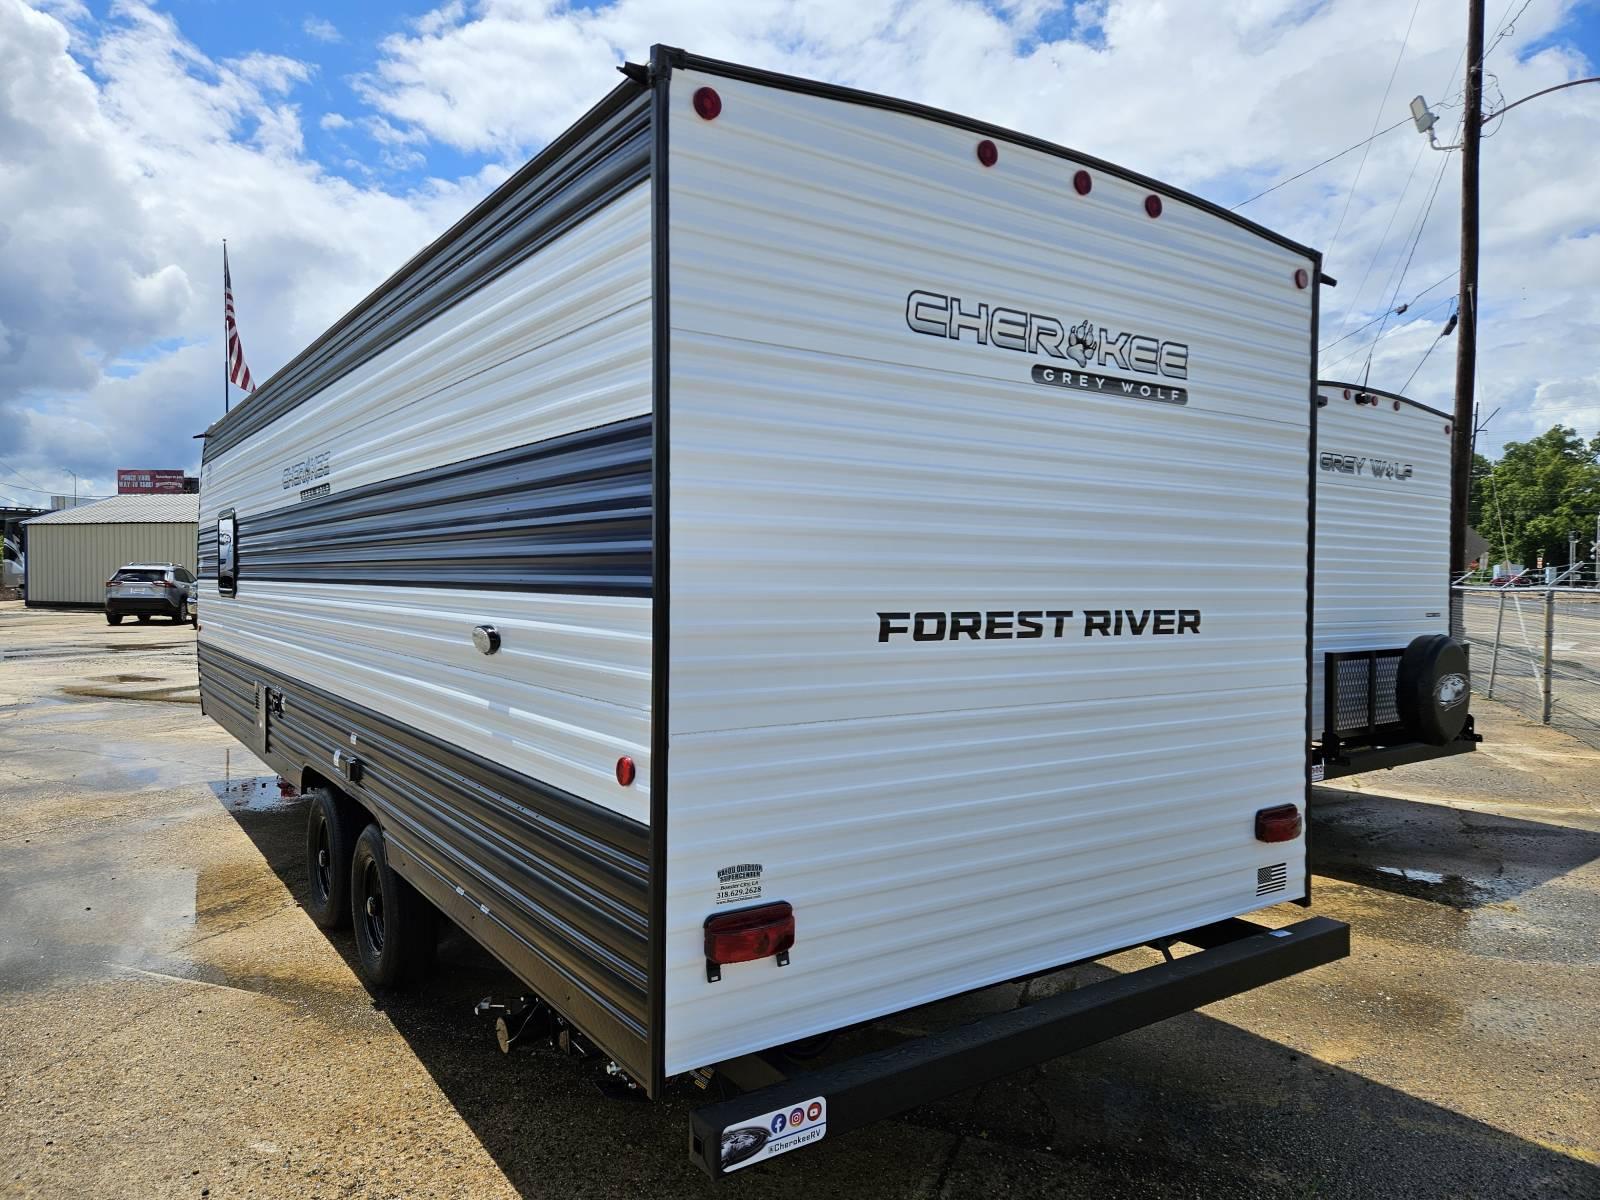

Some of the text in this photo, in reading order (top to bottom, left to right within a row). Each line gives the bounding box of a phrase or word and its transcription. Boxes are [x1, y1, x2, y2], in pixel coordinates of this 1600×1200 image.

[1042, 368, 1182, 402] GREY WOLF
[1320, 452, 1366, 476] GREY
[876, 609, 1201, 643] FOREST RIVER
[717, 886, 761, 898] 318.629.2628
